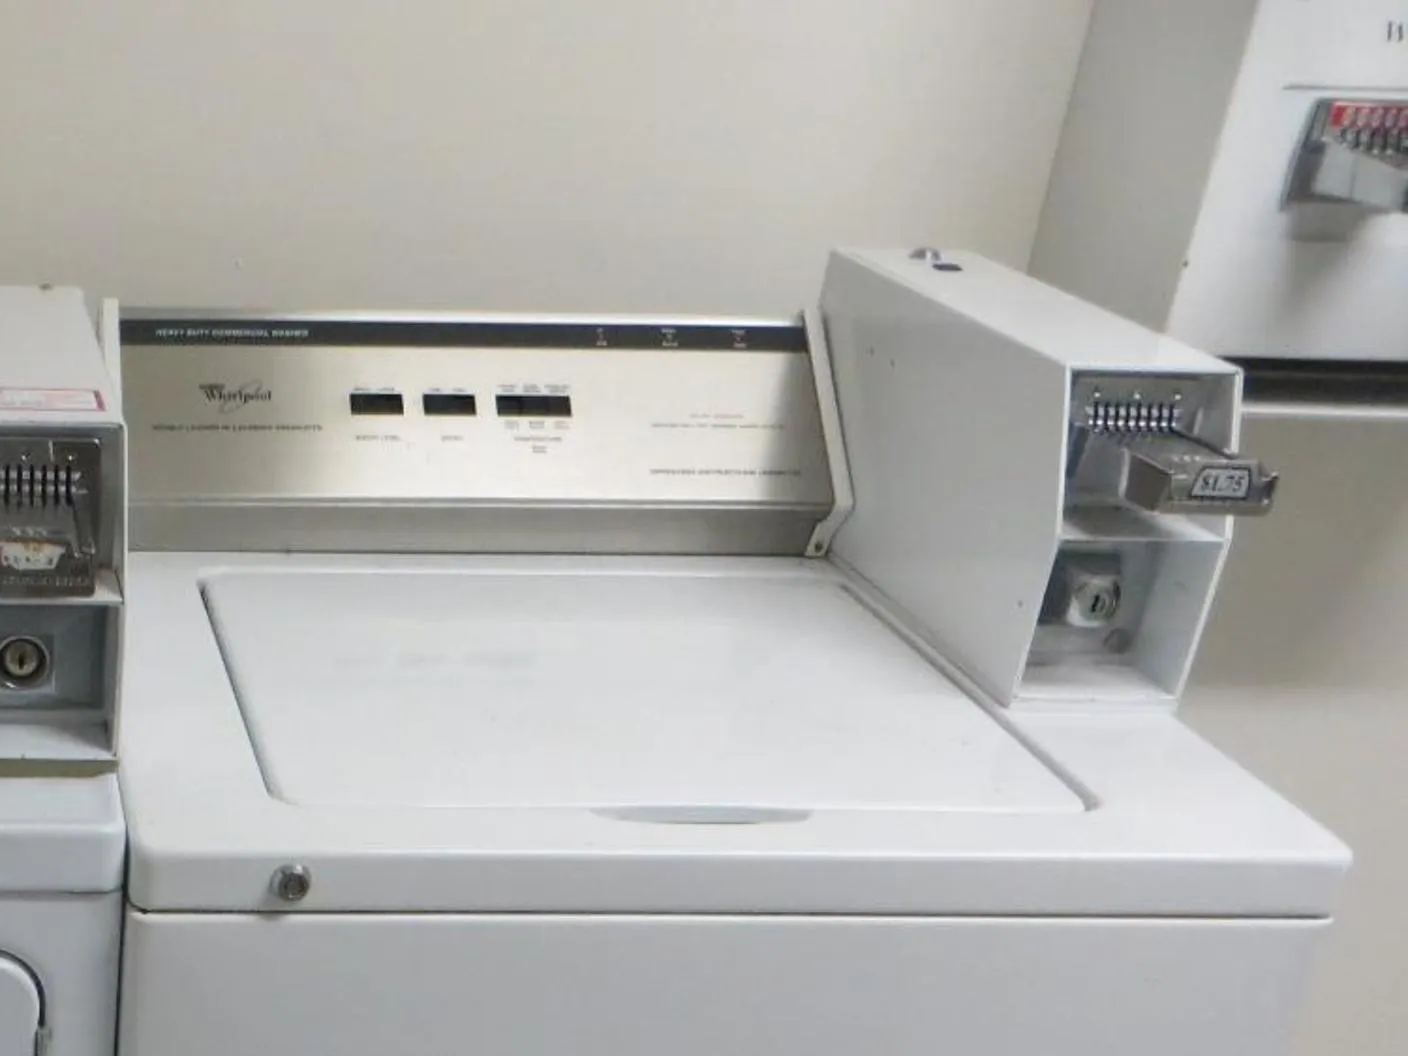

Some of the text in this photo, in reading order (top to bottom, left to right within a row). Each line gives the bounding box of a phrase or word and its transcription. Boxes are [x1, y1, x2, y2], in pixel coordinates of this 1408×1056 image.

[186, 328, 210, 338] DUTY
[211, 328, 269, 338] COMMERCIAL
[199, 382, 272, 405] Whirlpool
[1200, 473, 1245, 493] $1.75
